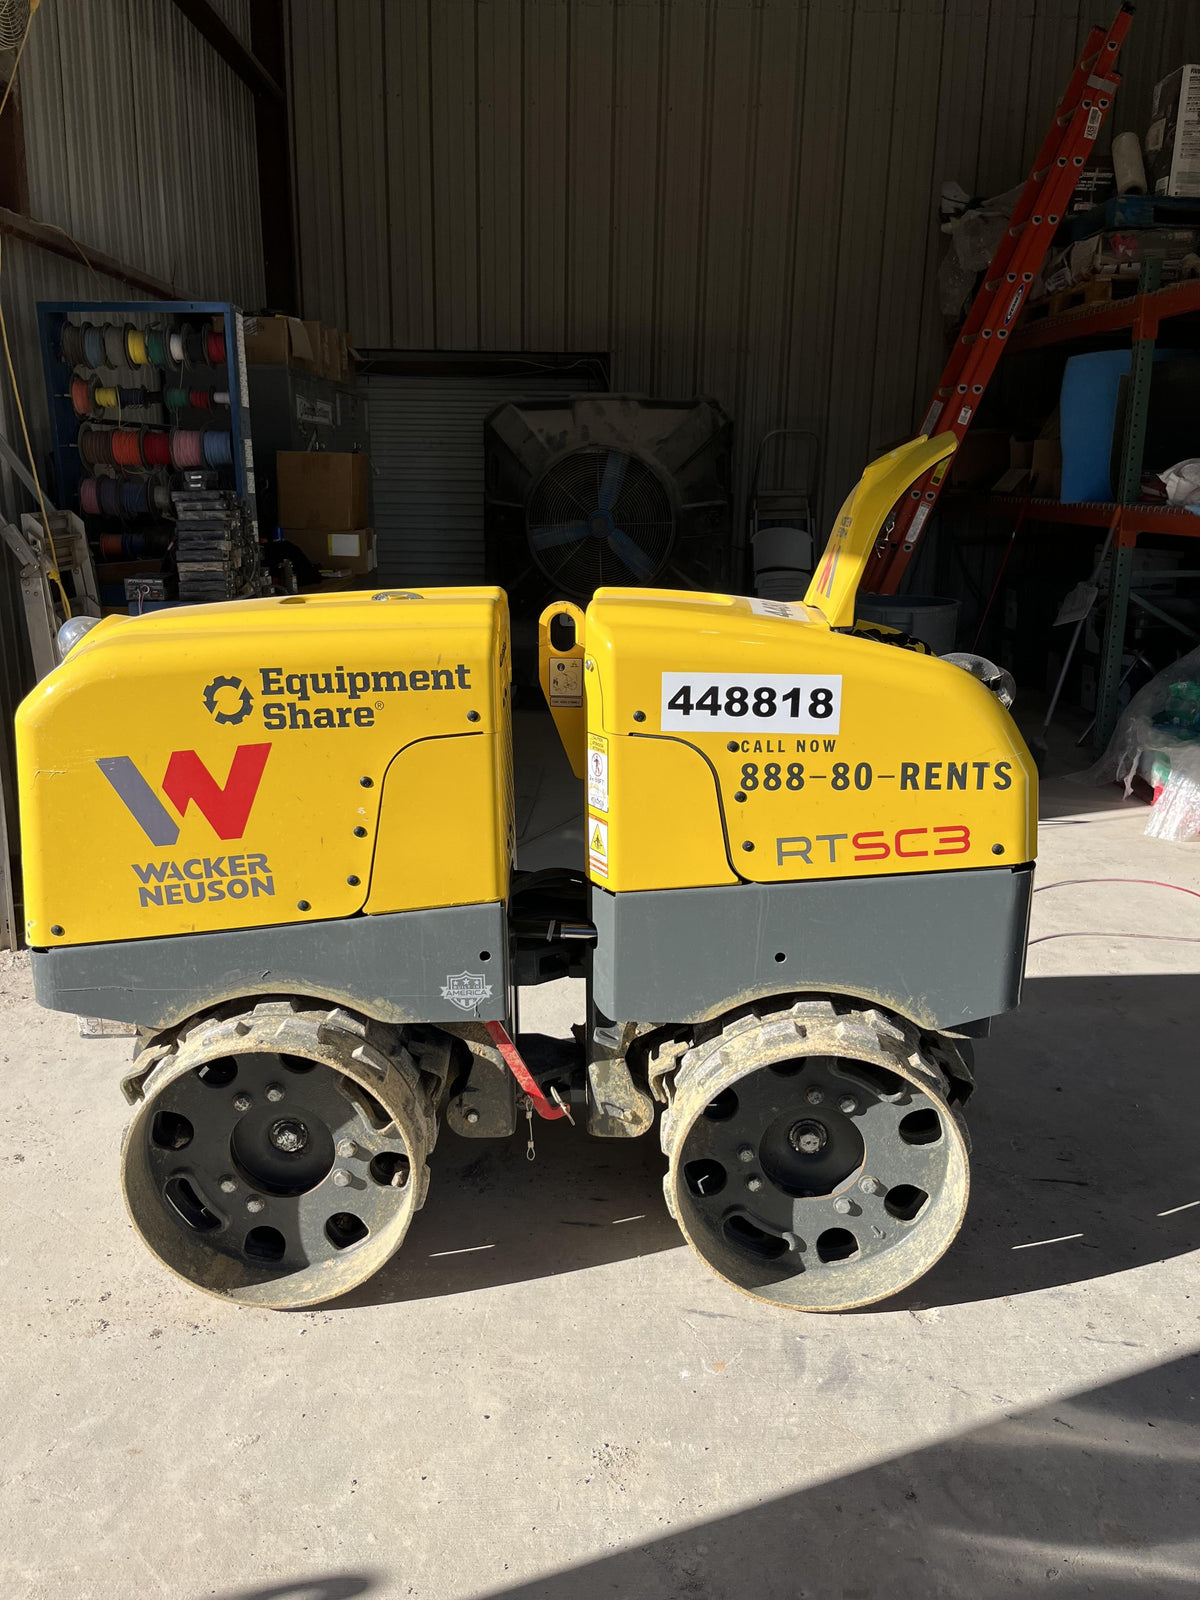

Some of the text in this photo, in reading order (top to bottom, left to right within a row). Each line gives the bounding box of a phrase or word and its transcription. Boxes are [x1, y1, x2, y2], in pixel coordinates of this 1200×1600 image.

[259, 664, 472, 702] Equipment
[668, 685, 834, 719] 448818
[740, 739, 836, 754] CALL NOW
[776, 825, 971, 866] RTSC3
[130, 853, 272, 885] WACKER
[138, 874, 276, 908] NEUSON
